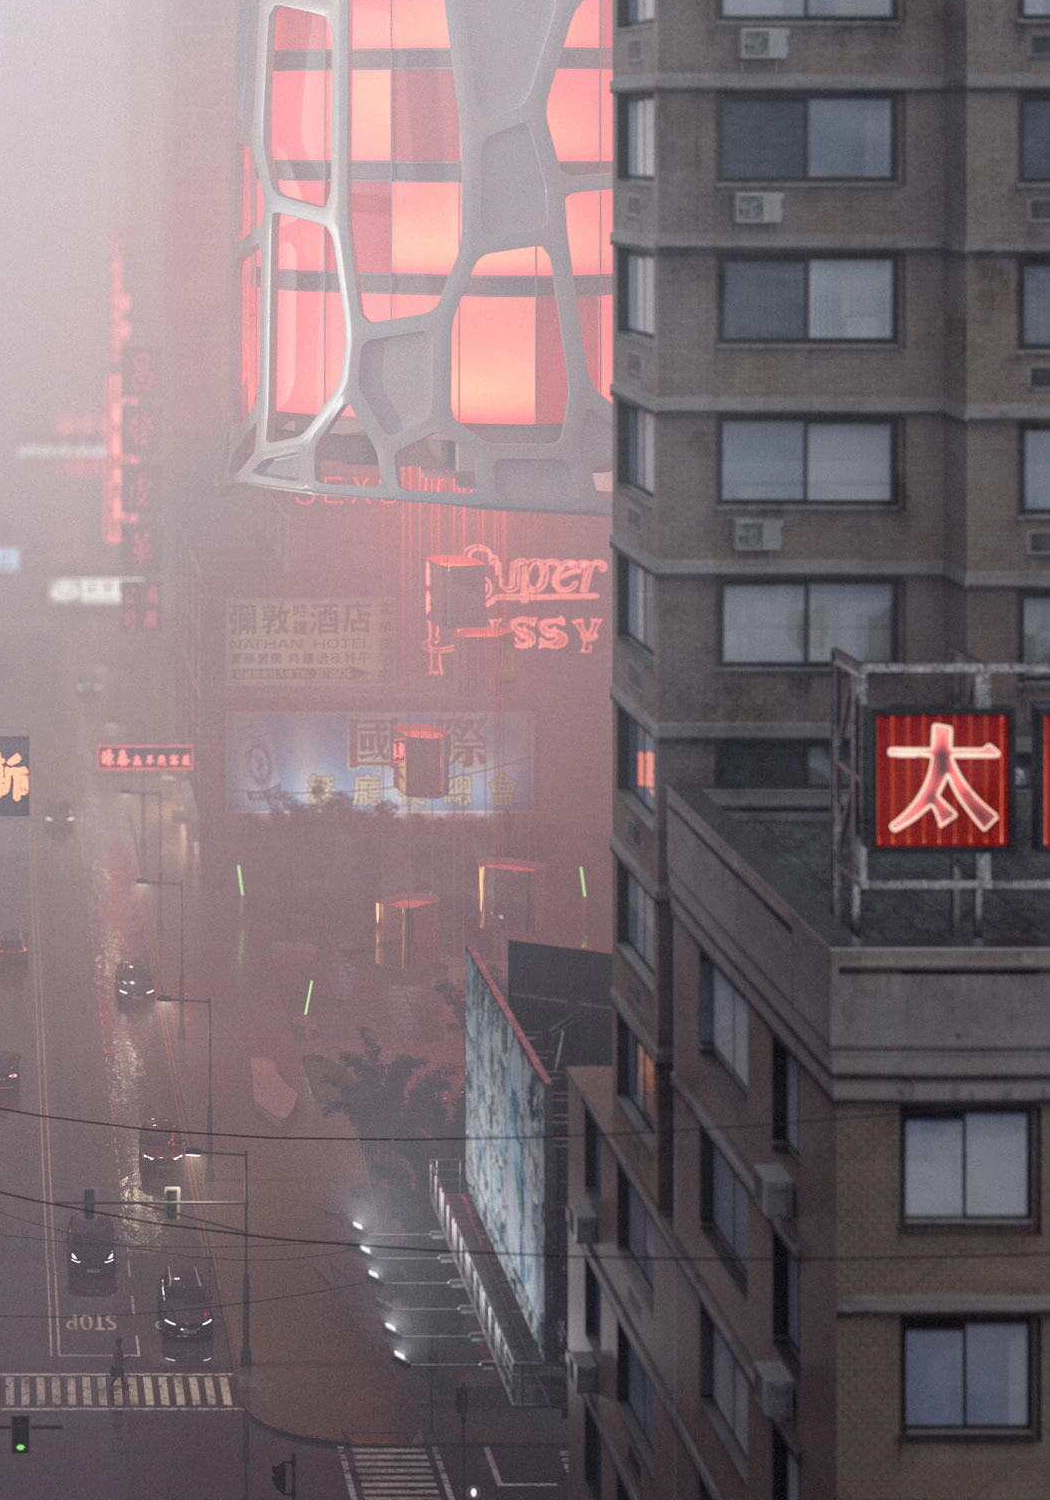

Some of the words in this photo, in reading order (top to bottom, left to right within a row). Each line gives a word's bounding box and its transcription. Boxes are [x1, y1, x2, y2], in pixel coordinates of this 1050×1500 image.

[229, 638, 303, 649] NATHAN
[313, 638, 371, 649] HOTEL
[886, 722, 1002, 833] 太
[65, 1314, 118, 1332] STOP
